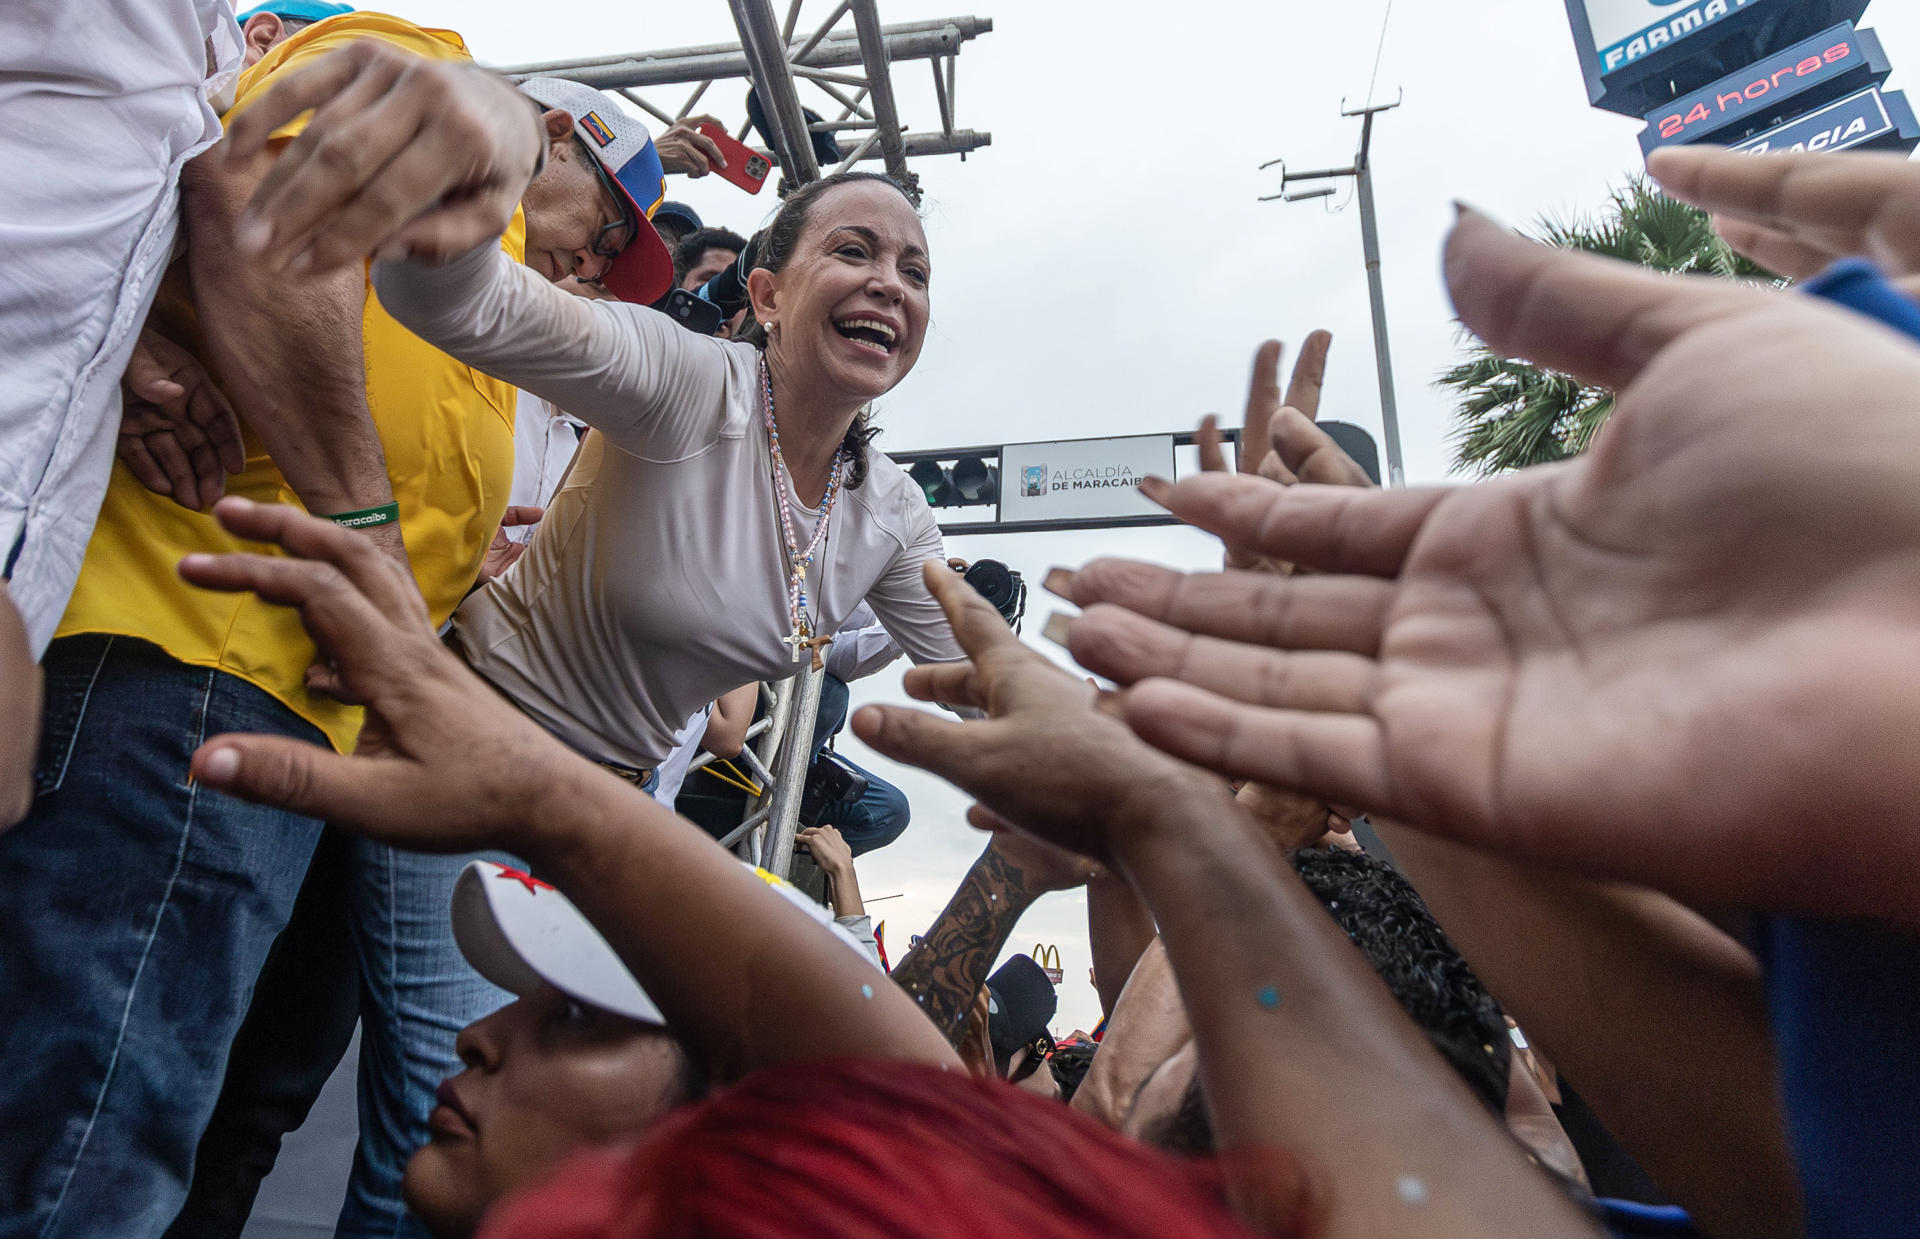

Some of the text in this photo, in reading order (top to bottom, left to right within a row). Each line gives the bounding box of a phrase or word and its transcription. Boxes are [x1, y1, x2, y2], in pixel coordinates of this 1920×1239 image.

[1658, 42, 1850, 138] 24 horas
[1052, 464, 1132, 480] ALCALDÍA
[1052, 477, 1145, 491] DE MARACAIB
